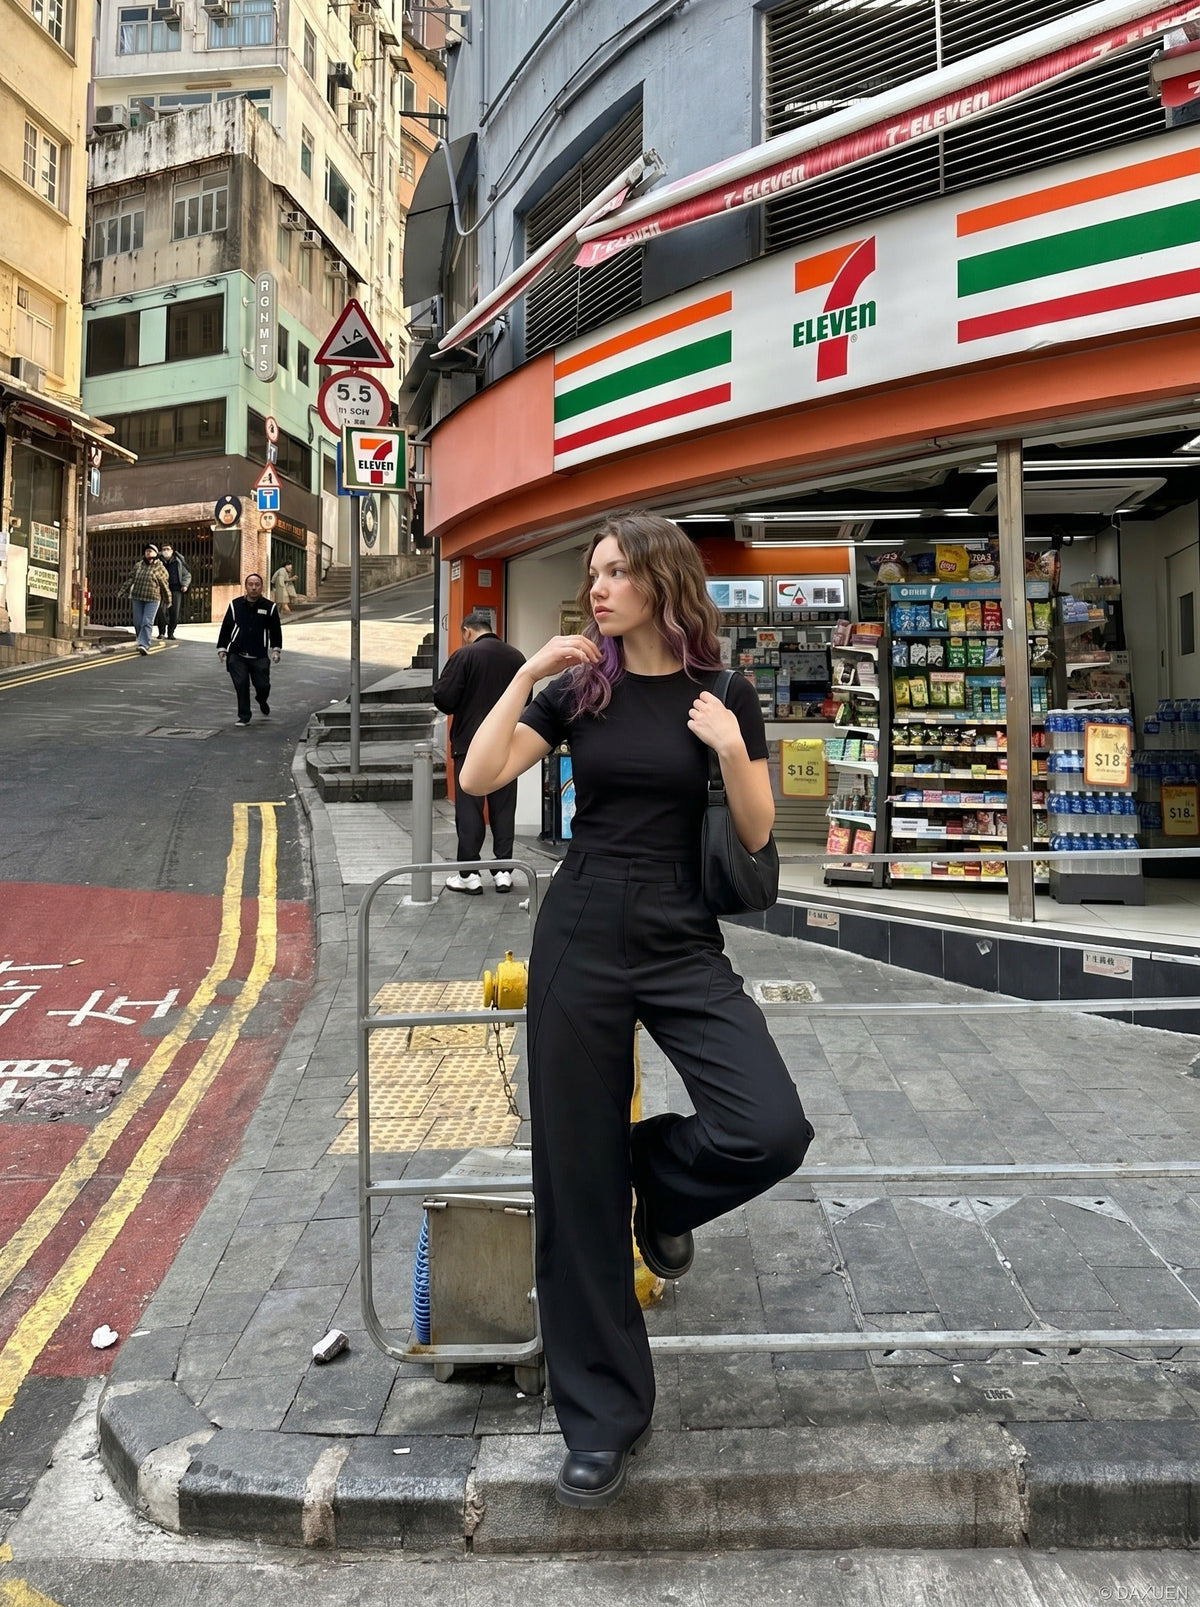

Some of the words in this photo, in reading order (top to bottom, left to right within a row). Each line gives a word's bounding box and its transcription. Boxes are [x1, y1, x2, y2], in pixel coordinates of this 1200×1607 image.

[260, 280, 269, 371] RGNMTS
[337, 383, 372, 403] 5.5
[1095, 753, 1120, 766] $18
